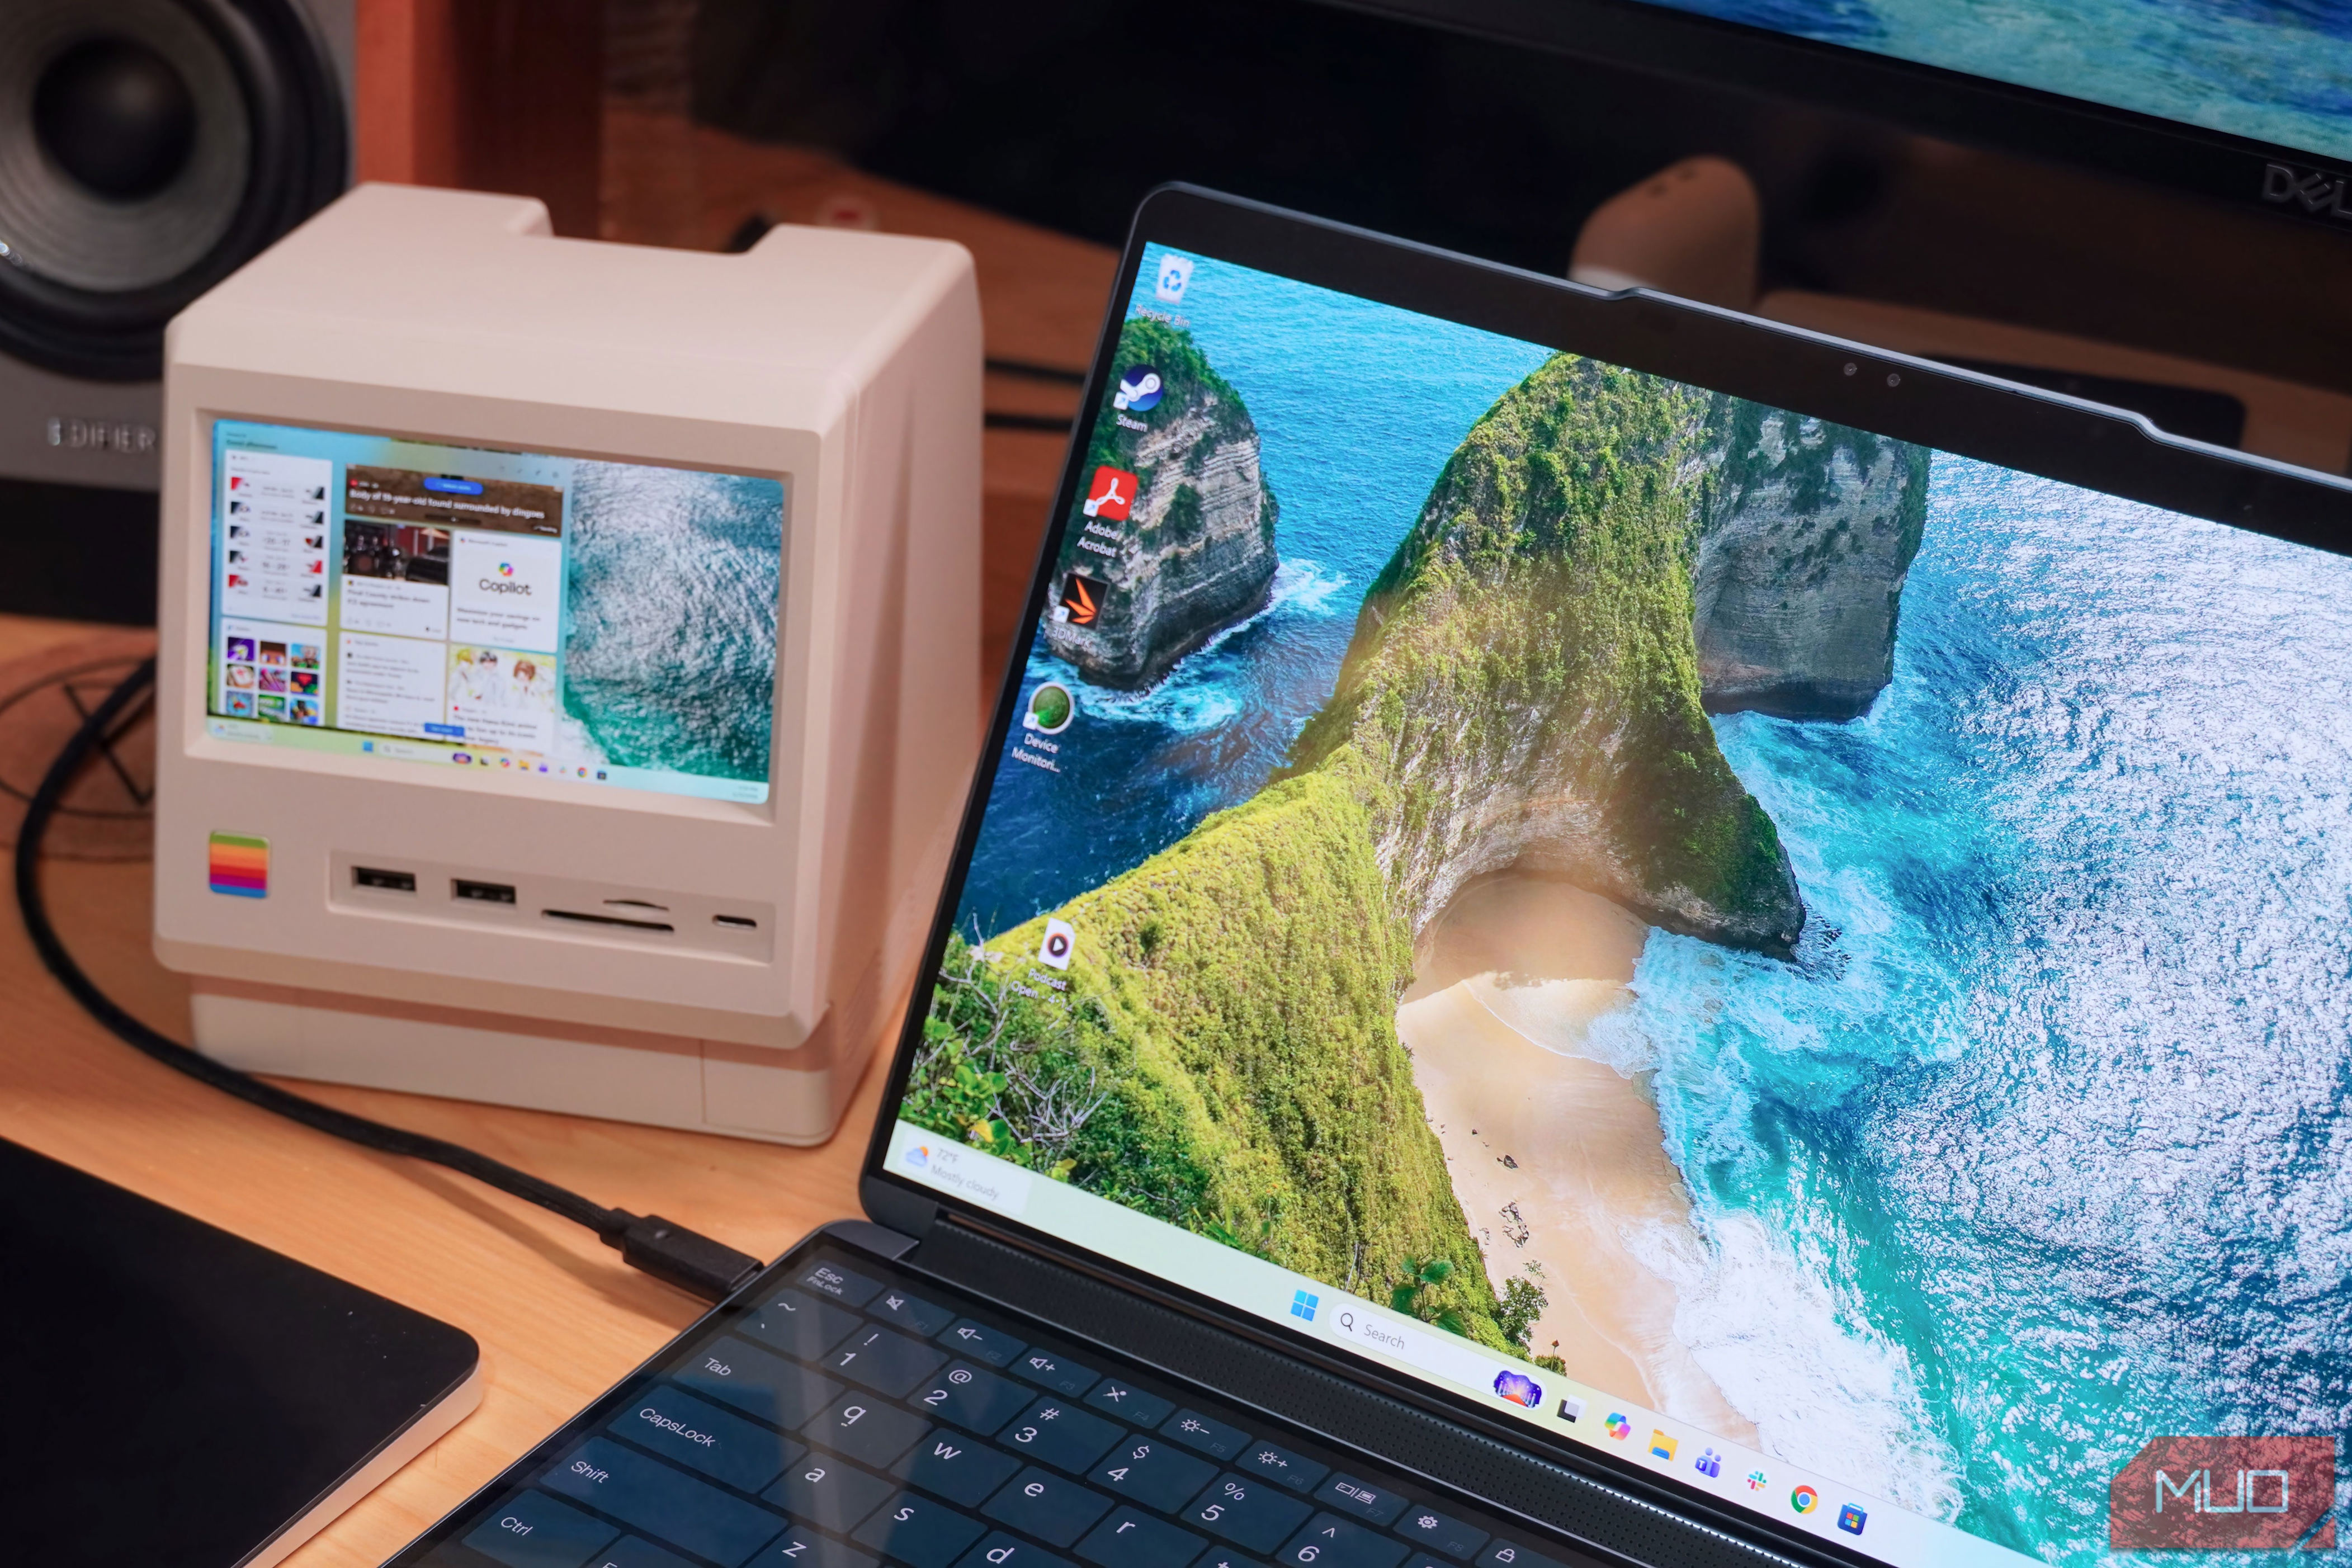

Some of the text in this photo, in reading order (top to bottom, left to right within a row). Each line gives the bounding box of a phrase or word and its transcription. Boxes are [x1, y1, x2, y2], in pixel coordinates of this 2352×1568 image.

[1135, 304, 1191, 328] Recycle Bin
[1116, 413, 1148, 432] Steam
[349, 489, 371, 501] Body
[372, 492, 382, 500] of
[428, 498, 452, 509] found
[453, 502, 499, 514] surrounded
[500, 505, 511, 517] by
[1084, 520, 1118, 540] Adobe
[1077, 536, 1117, 558] Acrobat
[479, 578, 532, 596] Copilot
[1052, 627, 1091, 648] 3DMark
[1024, 733, 1059, 754] Device
[1012, 747, 1061, 773] Monitori...
[1028, 968, 1067, 991] Podcast
[1010, 980, 1038, 999] Open
[936, 1147, 960, 1163] 72°F
[931, 1164, 1000, 1201] Mostly cloudy
[814, 1267, 844, 1284] Esc
[806, 1276, 843, 1295] FnLock
[863, 1333, 879, 1346] !
[1363, 1323, 1405, 1350] Search
[840, 1352, 856, 1366] 1
[985, 1350, 1002, 1361] F2
[704, 1357, 731, 1377] Tab
[948, 1369, 972, 1384] @
[1059, 1380, 1075, 1391] F3
[924, 1390, 948, 1406] 2
[843, 1405, 867, 1425] q
[1039, 1408, 1060, 1420] #
[1133, 1410, 1150, 1422] F4
[639, 1408, 716, 1448] CapsLock
[1015, 1427, 1038, 1443] 3
[1132, 1445, 1150, 1460] $
[570, 1461, 610, 1484] Shift
[805, 1467, 826, 1483] a
[1107, 1467, 1129, 1482] 4
[1287, 1473, 1303, 1485] F6
[1024, 1482, 1045, 1497] e
[1225, 1482, 1245, 1501] %
[1201, 1504, 1225, 1521] 5
[1366, 1508, 1384, 1519] F7
[500, 1516, 533, 1537] Ctrl
[1116, 1521, 1136, 1534] r
[1297, 1545, 1320, 1563] 6
[1447, 1541, 1465, 1552] F8
[986, 1547, 1015, 1565] d
